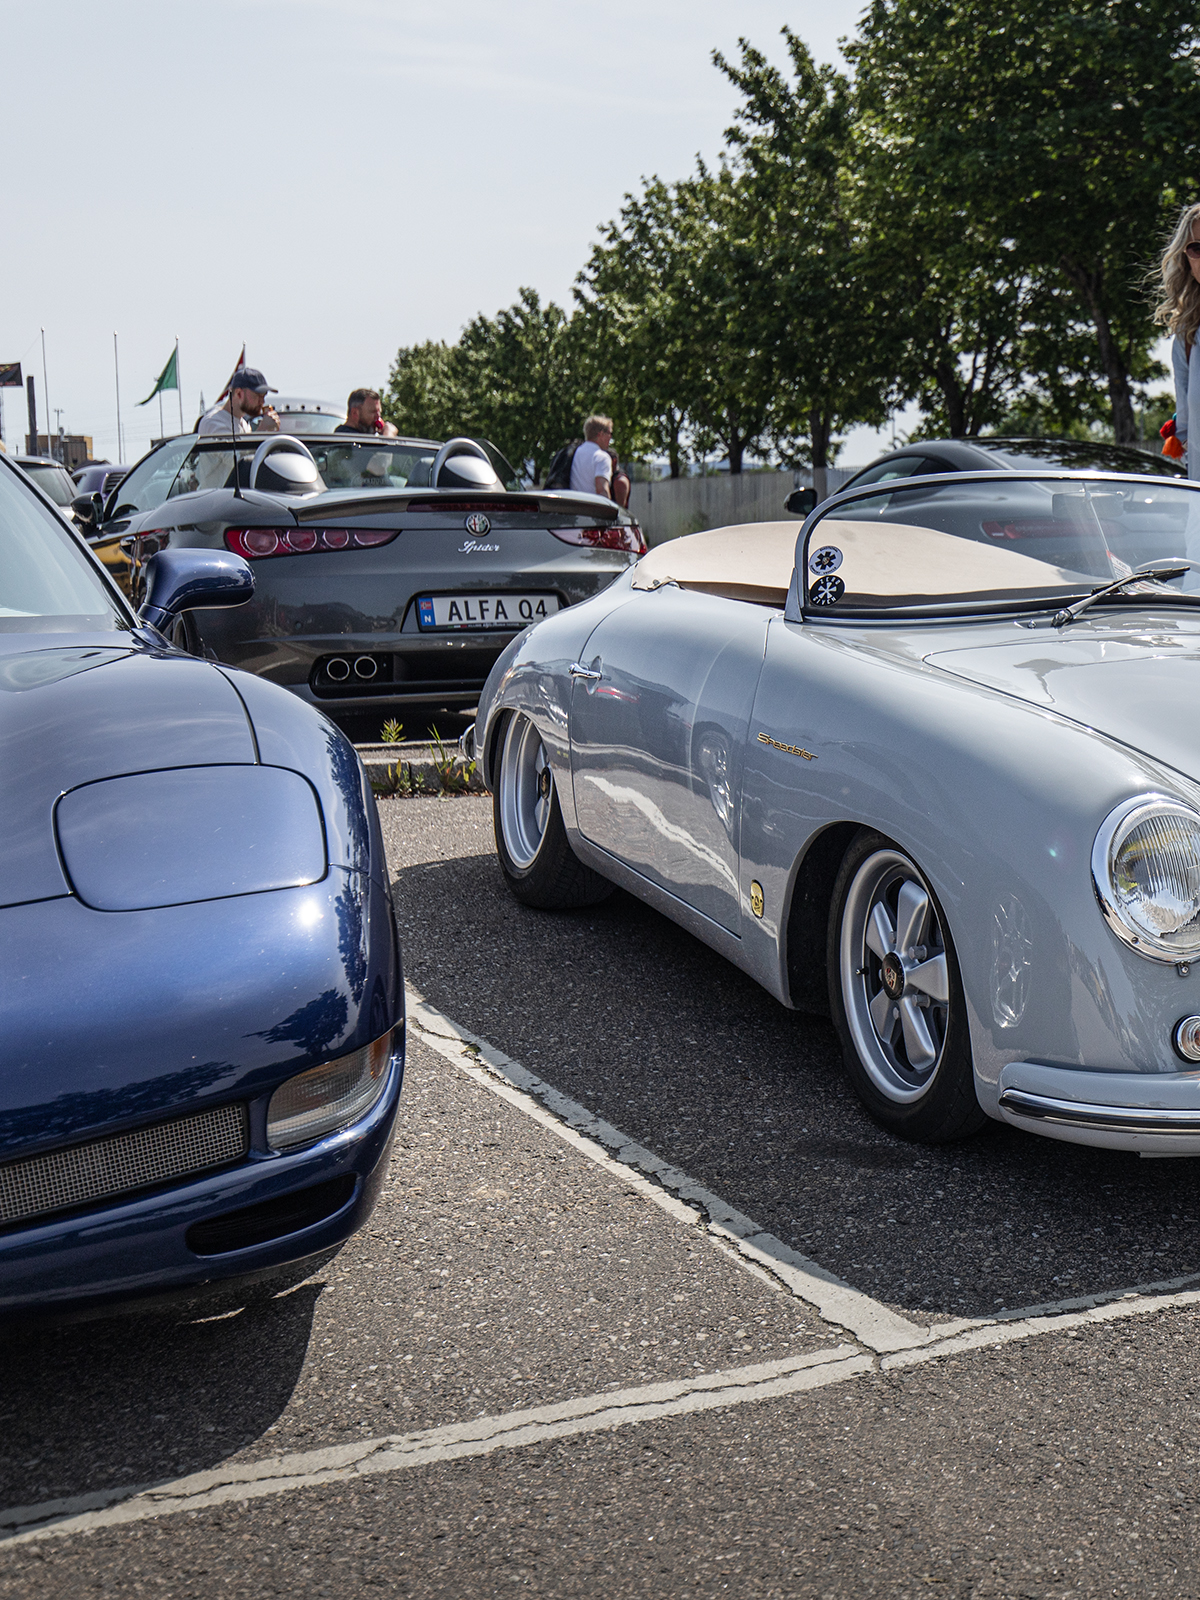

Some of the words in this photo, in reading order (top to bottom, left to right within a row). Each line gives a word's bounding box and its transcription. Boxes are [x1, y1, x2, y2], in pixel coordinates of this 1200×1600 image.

[458, 540, 500, 555] Spider
[820, 577, 841, 585] ZERO
[813, 597, 837, 605] GIVEN
[448, 599, 508, 621] ALFA
[518, 599, 548, 620] Q4
[424, 615, 432, 623] N
[757, 732, 819, 761] Speedster
